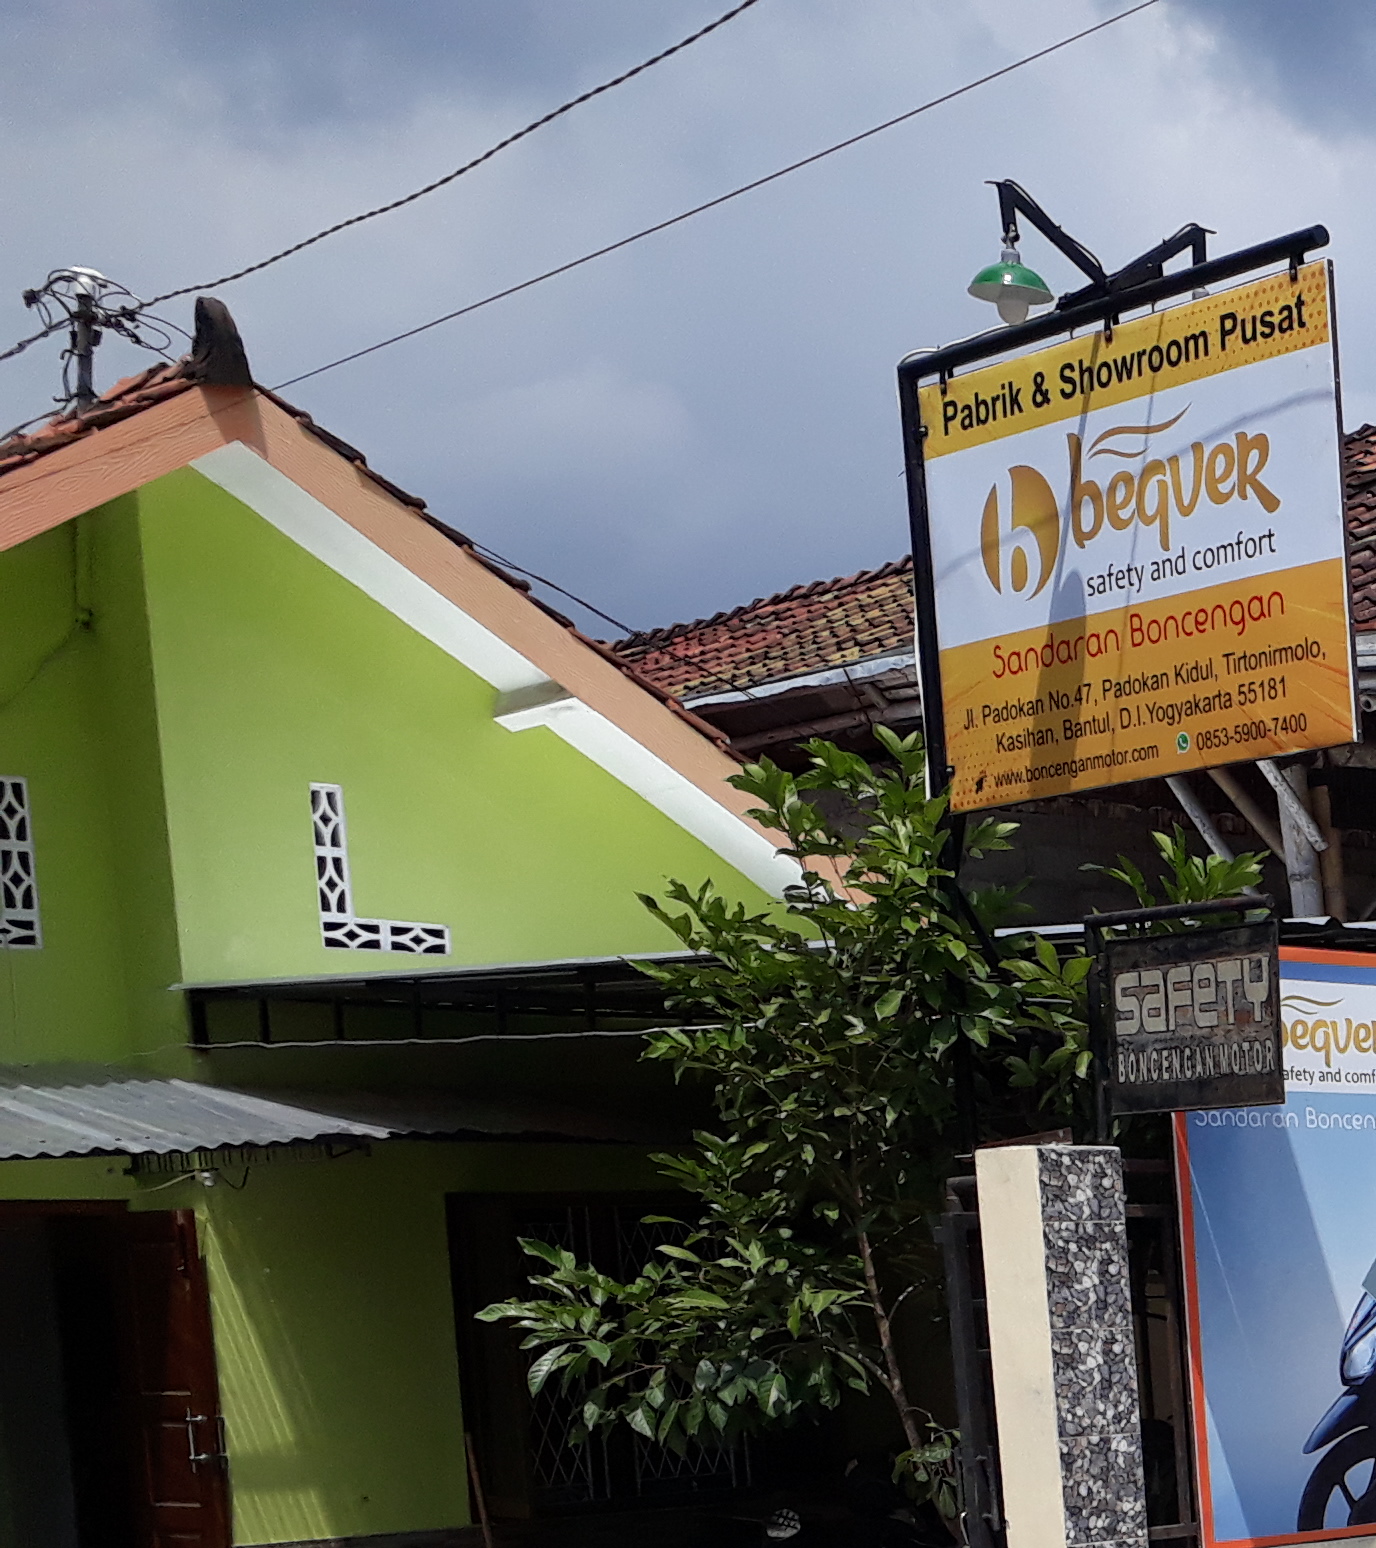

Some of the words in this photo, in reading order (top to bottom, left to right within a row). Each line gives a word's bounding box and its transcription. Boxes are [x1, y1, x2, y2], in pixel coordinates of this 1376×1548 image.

[942, 380, 1024, 436] Pabrik
[1031, 371, 1050, 408] &
[1059, 330, 1209, 400] Showroom
[1219, 300, 1306, 352] Pusat
[1087, 564, 1144, 597] safety
[1151, 547, 1186, 581] and
[1193, 529, 1276, 572] comfort
[992, 627, 1120, 679] Sandaran
[1130, 591, 1285, 648] Boncengan
[982, 697, 1044, 727] Padokan
[1049, 684, 1097, 711] No.47,
[1102, 670, 1169, 699] Padokan
[1174, 658, 1218, 687] Kidul,
[1223, 637, 1327, 676] Tirtonirmolo,
[996, 725, 1059, 754] Kasihan,
[1063, 714, 1114, 741] Bantul,
[1120, 691, 1233, 730] D.I.Yogyakarta
[1237, 676, 1288, 707] 55181
[994, 744, 1159, 788] www.boncenganmotor.com
[1196, 713, 1307, 751] 0853-5900-7400
[1118, 1045, 1214, 1083] BONCENGAN
[1218, 1039, 1275, 1074] MOTOR
[1282, 1069, 1315, 1086] afety
[1318, 1068, 1341, 1083] and
